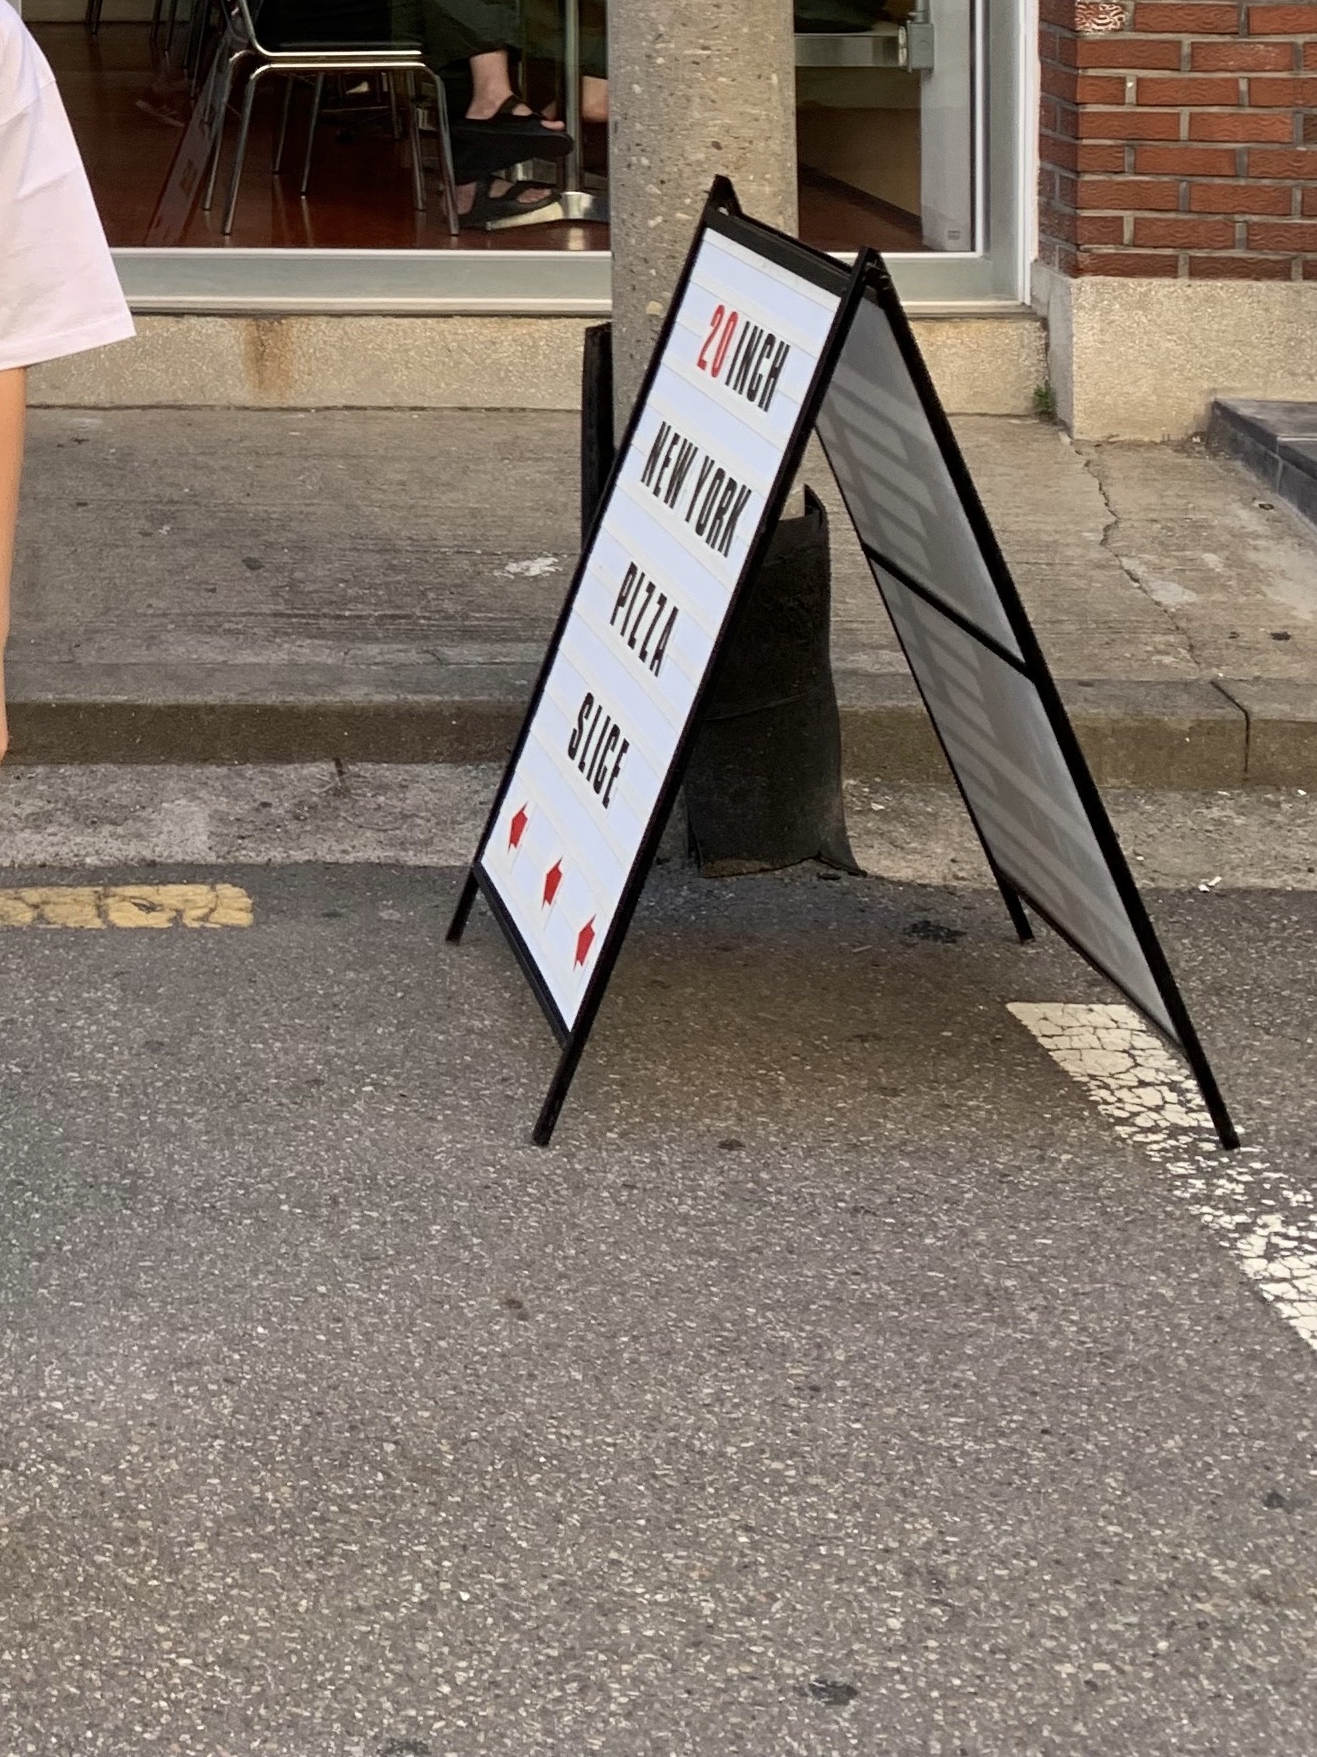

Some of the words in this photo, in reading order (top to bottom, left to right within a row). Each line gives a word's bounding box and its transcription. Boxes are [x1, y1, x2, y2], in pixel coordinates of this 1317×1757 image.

[697, 304, 739, 378] 20
[724, 319, 791, 413] INCH
[640, 420, 698, 510] NEW
[684, 454, 753, 558] YORK
[609, 560, 679, 678] PIZZA
[567, 692, 630, 810] SLICE
